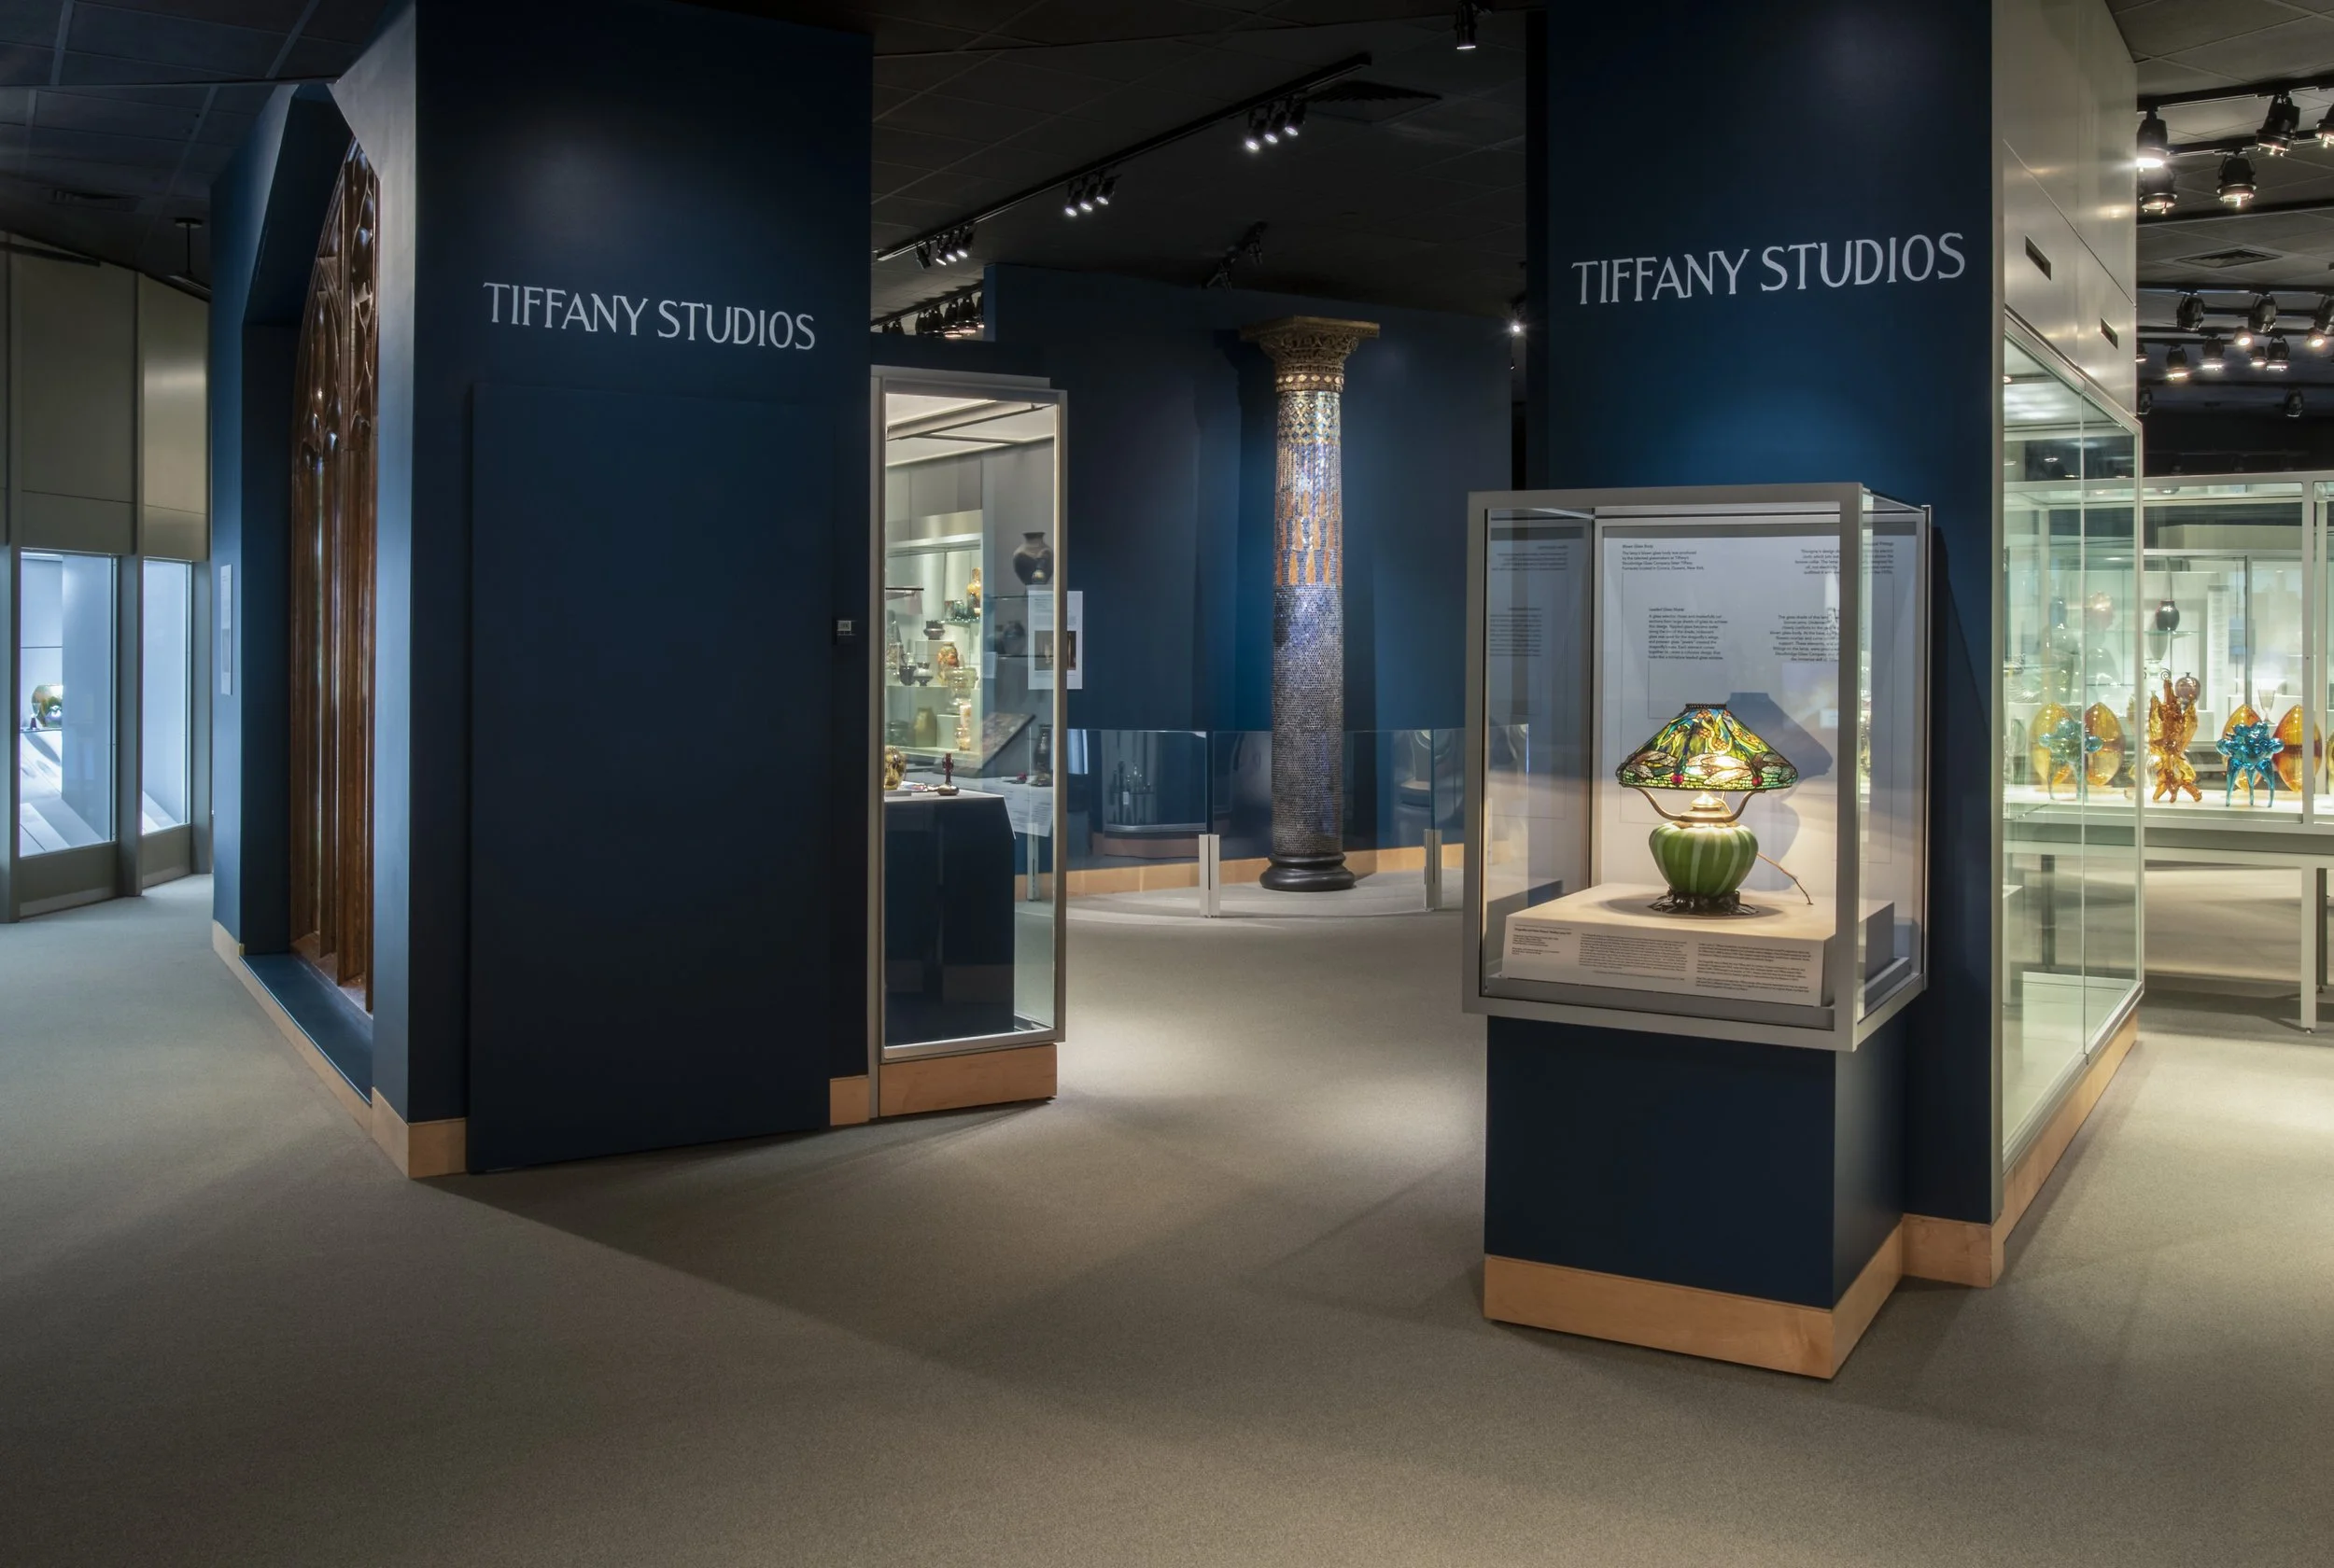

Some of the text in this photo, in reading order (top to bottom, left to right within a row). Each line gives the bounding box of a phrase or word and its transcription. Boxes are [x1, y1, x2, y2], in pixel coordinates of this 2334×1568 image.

[1571, 231, 1965, 304] TIFFANY STUDIOS
[483, 282, 816, 350] TIFFANY STUDIOS
